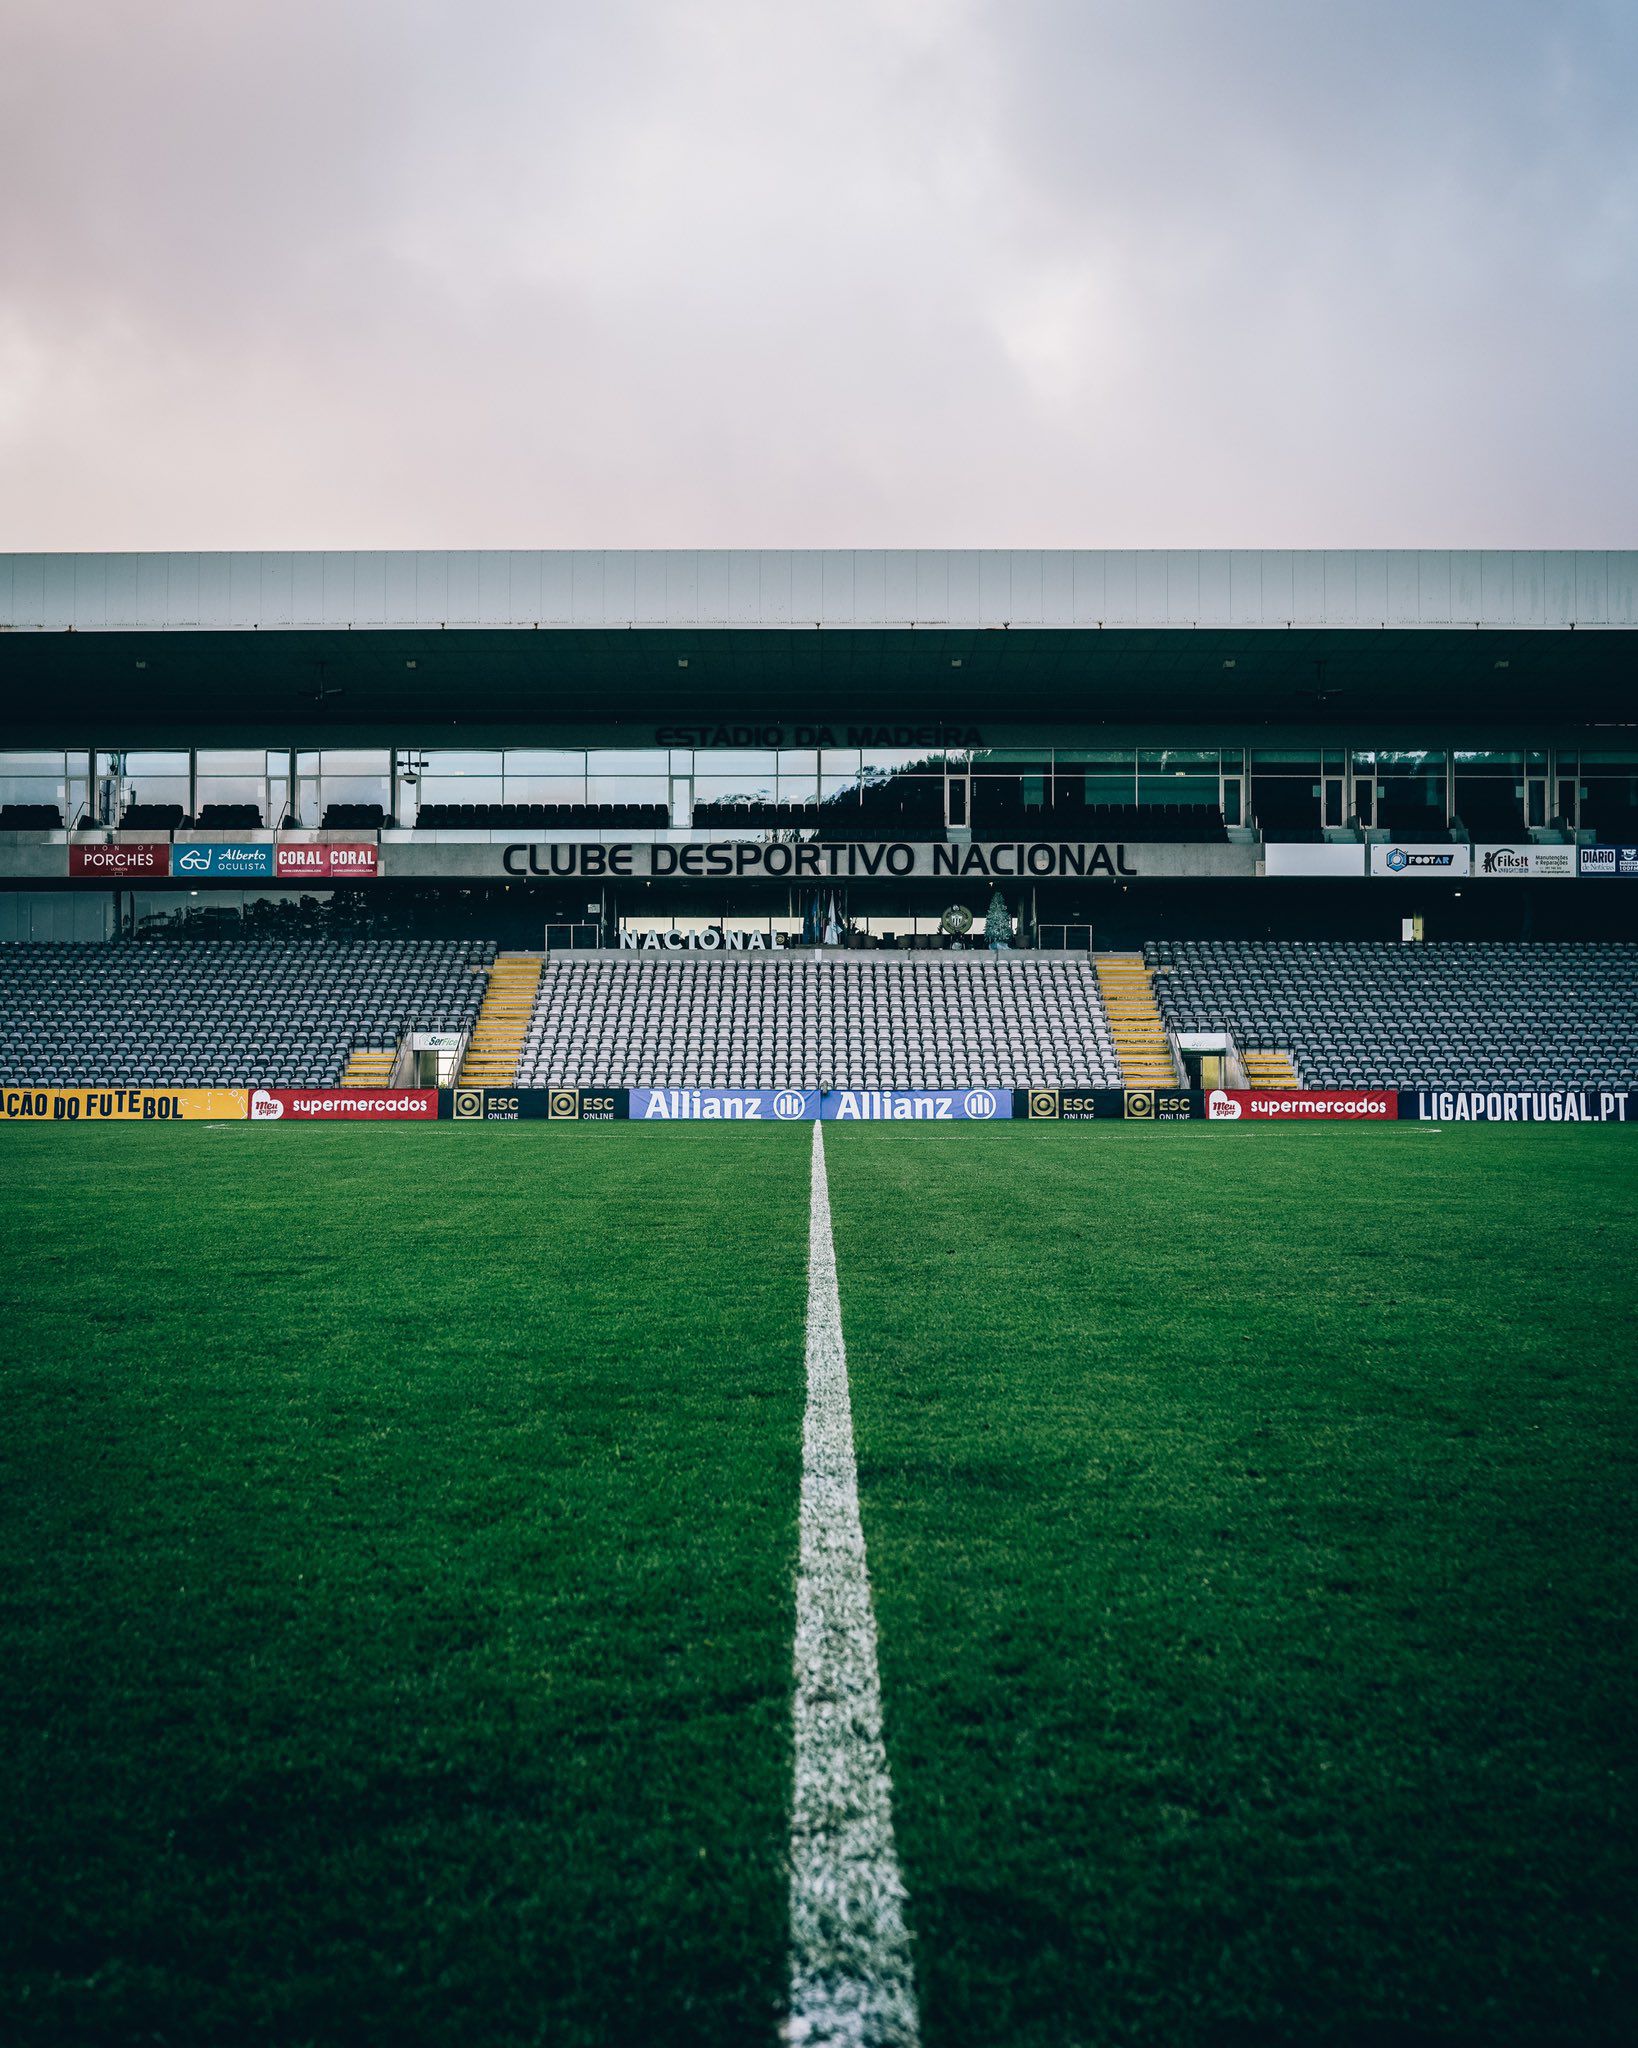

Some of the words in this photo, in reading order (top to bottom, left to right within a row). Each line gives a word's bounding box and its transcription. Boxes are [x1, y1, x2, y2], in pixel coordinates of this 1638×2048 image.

[795, 727, 833, 747] DA
[848, 727, 983, 747] MADEIRA
[84, 853, 154, 866] PORCHES
[218, 848, 266, 861] Alberto
[279, 851, 324, 865] CORAL
[330, 850, 375, 865] CORAL
[503, 844, 632, 876] CLUBE
[651, 843, 915, 876] DESPORTIVO
[933, 843, 1137, 876] NACIONAL
[1497, 855, 1529, 867] Fiks!t
[218, 862, 266, 871] OCULISTA
[619, 929, 784, 950] NACIONAL
[53, 1096, 79, 1119] DO
[86, 1090, 183, 1119] FUTEBOL
[293, 1096, 427, 1115] supermercados
[488, 1098, 519, 1110] ESC
[583, 1098, 614, 1110] ESC
[644, 1091, 762, 1119] Allianz
[836, 1091, 953, 1120] Allianz
[1063, 1098, 1094, 1111] ESC
[1159, 1098, 1190, 1111] ESC
[1251, 1098, 1386, 1116] supermercados
[1419, 1092, 1629, 1121] LIGAPORTUGAL.PT
[488, 1112, 519, 1120] ONLINE
[583, 1112, 614, 1120] ONLINE
